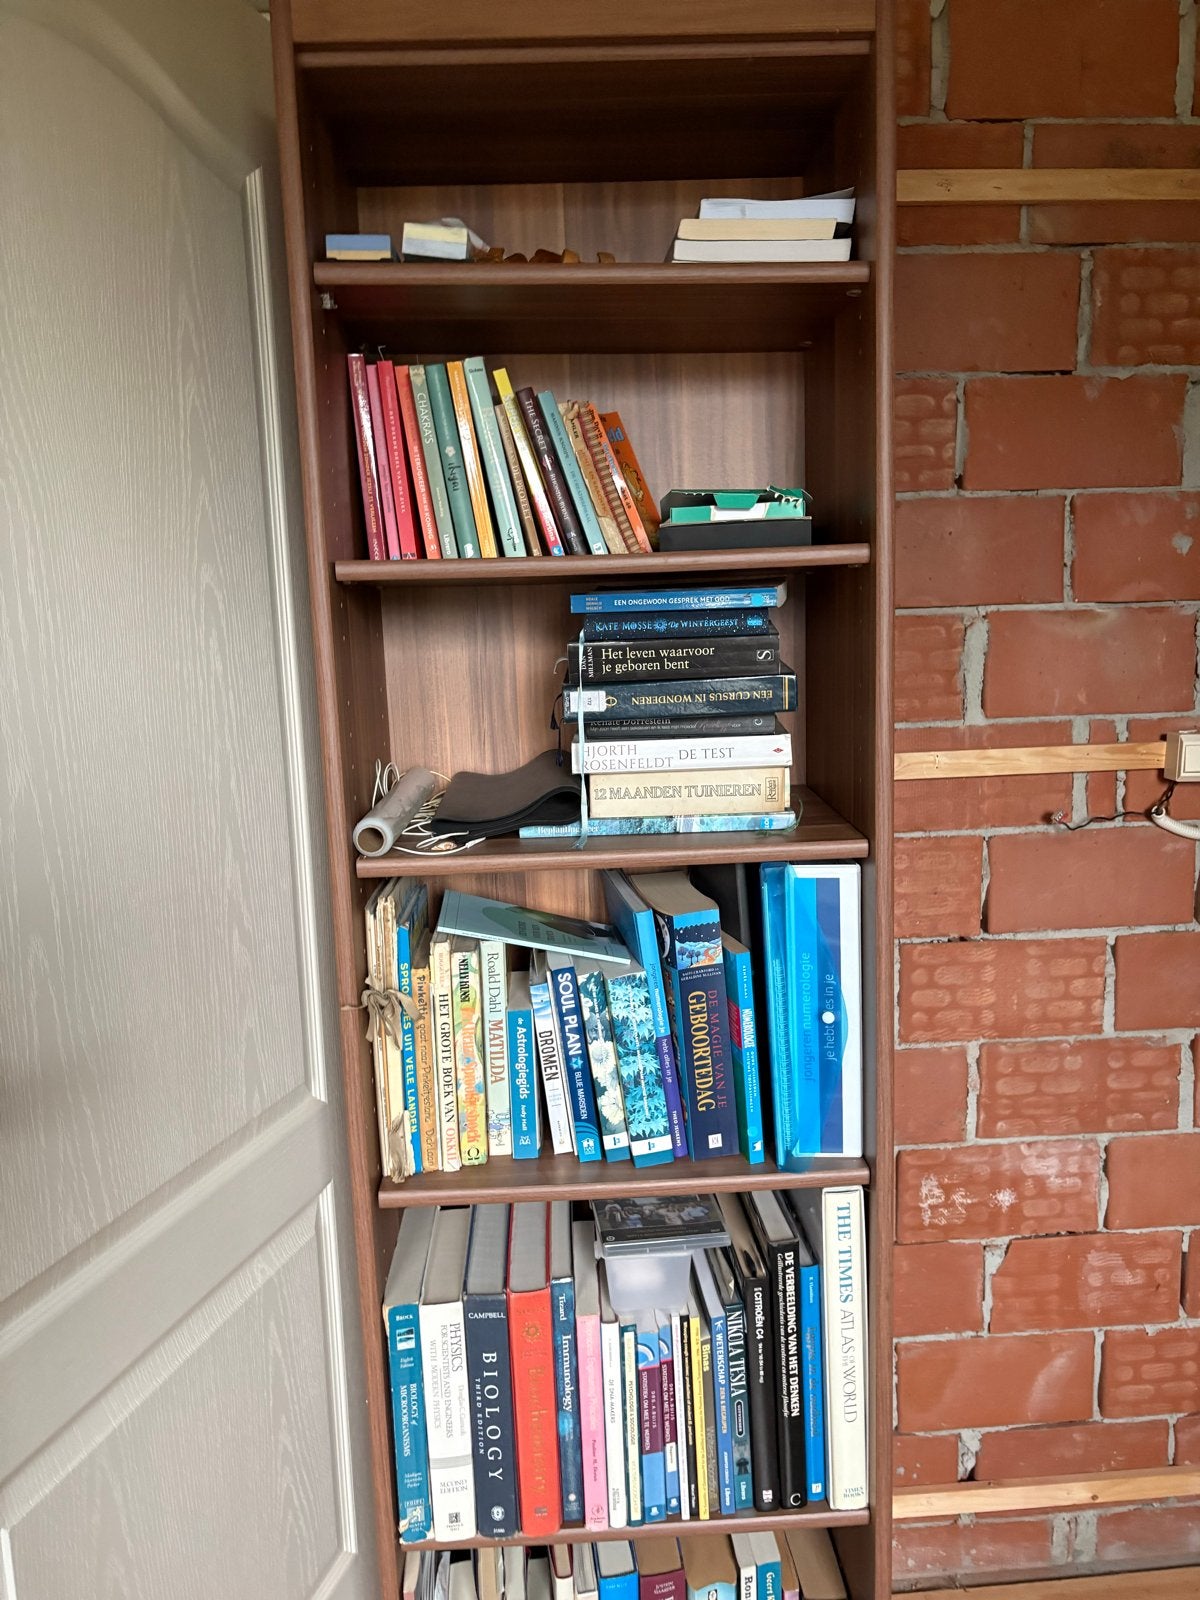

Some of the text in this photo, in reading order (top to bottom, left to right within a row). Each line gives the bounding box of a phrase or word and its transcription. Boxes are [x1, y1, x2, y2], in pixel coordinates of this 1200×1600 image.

[416, 391, 433, 444] CHAKRA'S
[524, 398, 537, 419] THE
[530, 418, 548, 452] SECRET
[413, 453, 434, 540] TERUGKEER KONING
[515, 478, 533, 521] PROFEET
[549, 472, 563, 500] RHONDA
[443, 533, 452, 554] Librero
[595, 622, 618, 630] KATE
[622, 621, 652, 630] MOSSE
[680, 619, 738, 628] WINTERGEEST
[601, 646, 715, 659] Het leven waarvoor
[602, 659, 689, 673] je geboren bent
[632, 690, 773, 705] EEN CURSUS IN WONDEREN
[584, 745, 637, 757] HJORTH
[679, 748, 735, 760] DE TEST
[594, 784, 761, 800] 12 MAANDEN TUINIEREN
[458, 958, 469, 979] NELLY
[439, 993, 449, 1018] HET
[459, 980, 470, 1002] KUNST
[416, 1023, 426, 1042] gaat
[487, 952, 505, 1083] Roald Dahl MATILDA
[557, 972, 581, 1055] SOUL PLAN
[740, 1007, 755, 1048] NUMEROLOGIE
[824, 974, 837, 1061] je hebt in je
[440, 1022, 451, 1063] GROTE
[514, 1026, 529, 1099] Astrologiegids
[538, 1029, 559, 1081] DROMEN
[661, 1038, 669, 1052] hebt
[663, 1053, 671, 1068] alles
[686, 990, 716, 1112] GEBOORTEDAG
[707, 989, 727, 1109] DE MAGIE VAN JE
[404, 1033, 417, 1133] UIT VELE LANDEN
[442, 1067, 453, 1098] BOEK
[574, 1071, 587, 1119] BLUE MARSDEN
[444, 1101, 454, 1123] VAN
[837, 1202, 851, 1240] THE
[837, 1246, 852, 1303] TIMES
[558, 1293, 567, 1320] Tizard
[753, 1291, 765, 1339] CITROËN C4
[777, 1291, 785, 1324] geschiedenis
[448, 1322, 463, 1372] PHYSICS
[784, 1251, 800, 1416] DE VERBEELDING VAN HET DENKEN
[839, 1308, 855, 1353] ATLAS
[559, 1333, 574, 1412] Immunology
[701, 1343, 711, 1371] Binas
[715, 1332, 726, 1384] WETENSCHAP
[726, 1310, 747, 1397] NIKOLA TESLA
[409, 1383, 418, 1418] BIOLOGY
[428, 1339, 441, 1428] WITH MODERN PHYSICS
[439, 1324, 453, 1439] FOR SCIENTISTS AND ENGINEERS
[662, 1392, 668, 1401] OM
[842, 1367, 857, 1422] WORLD
[399, 1384, 410, 1457] MICROORGANISMS
[474, 1377, 484, 1455] THIRD EDITION
[482, 1351, 503, 1481] BIOLOGY
[642, 1399, 648, 1408] OM
[766, 1572, 775, 1594] Geert
